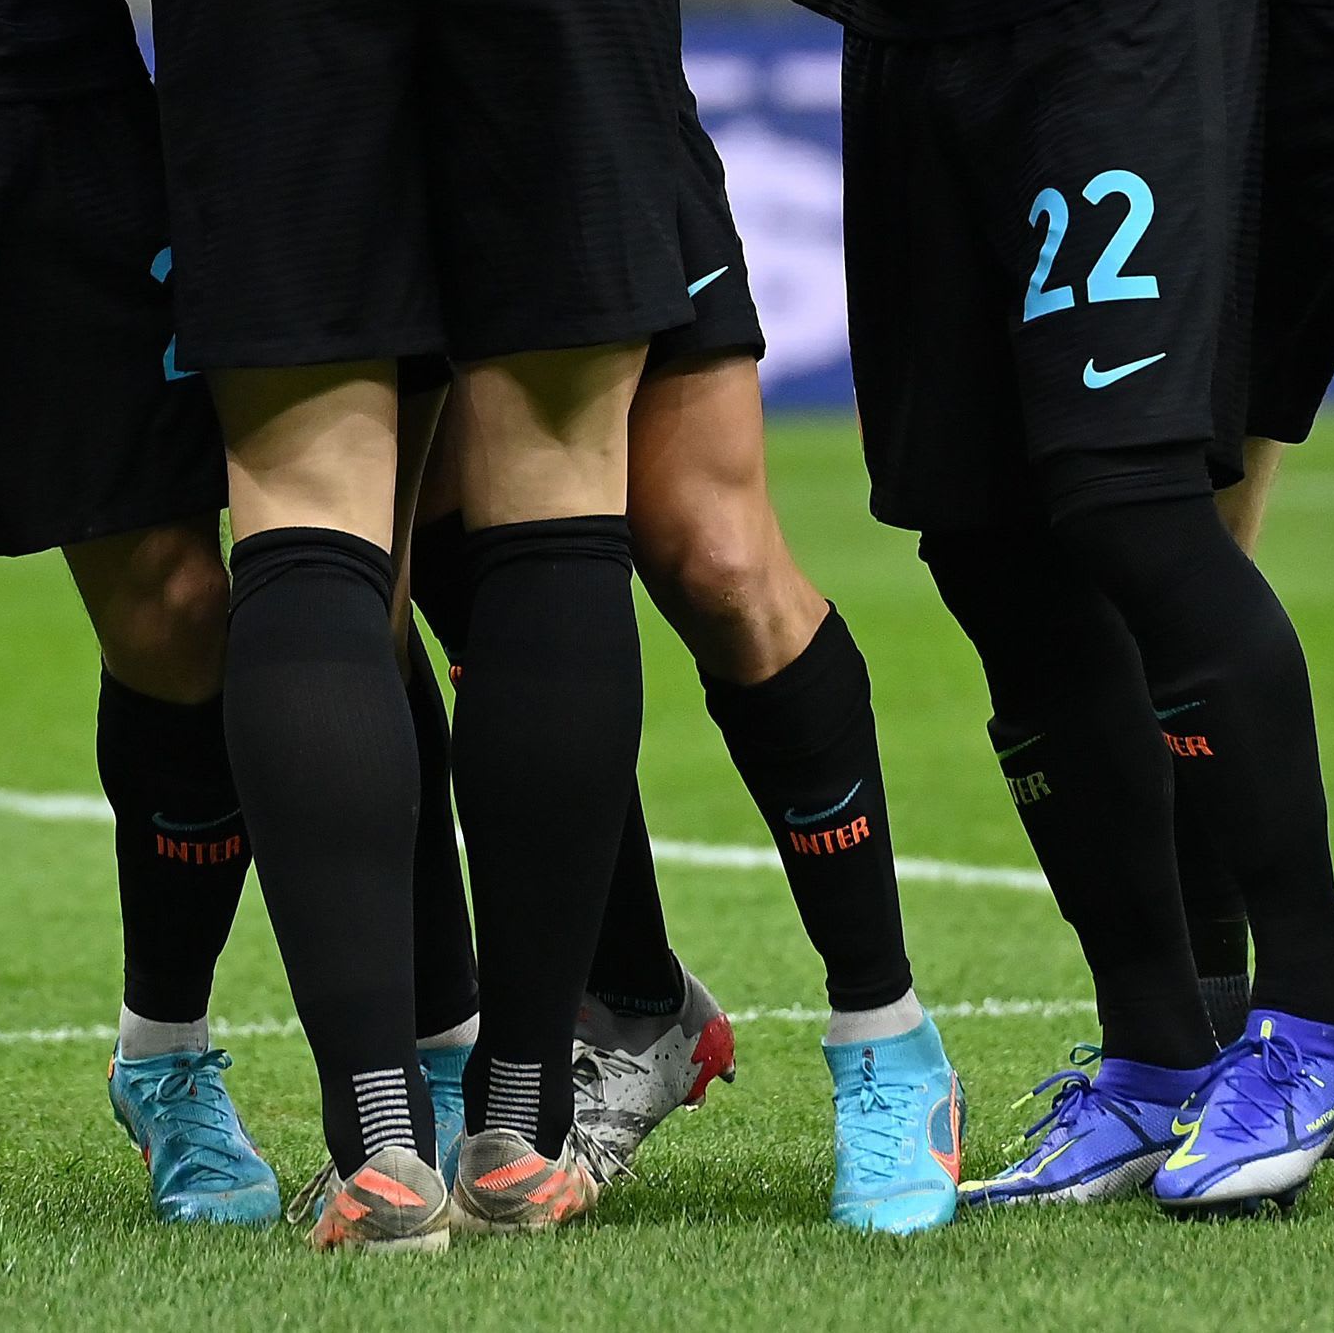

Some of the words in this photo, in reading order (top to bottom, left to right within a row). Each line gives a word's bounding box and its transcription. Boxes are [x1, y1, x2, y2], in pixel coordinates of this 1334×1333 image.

[1023, 169, 1160, 323] 22
[1005, 770, 1053, 806] TER
[155, 833, 241, 865] INTER
[789, 815, 870, 856] INTER
